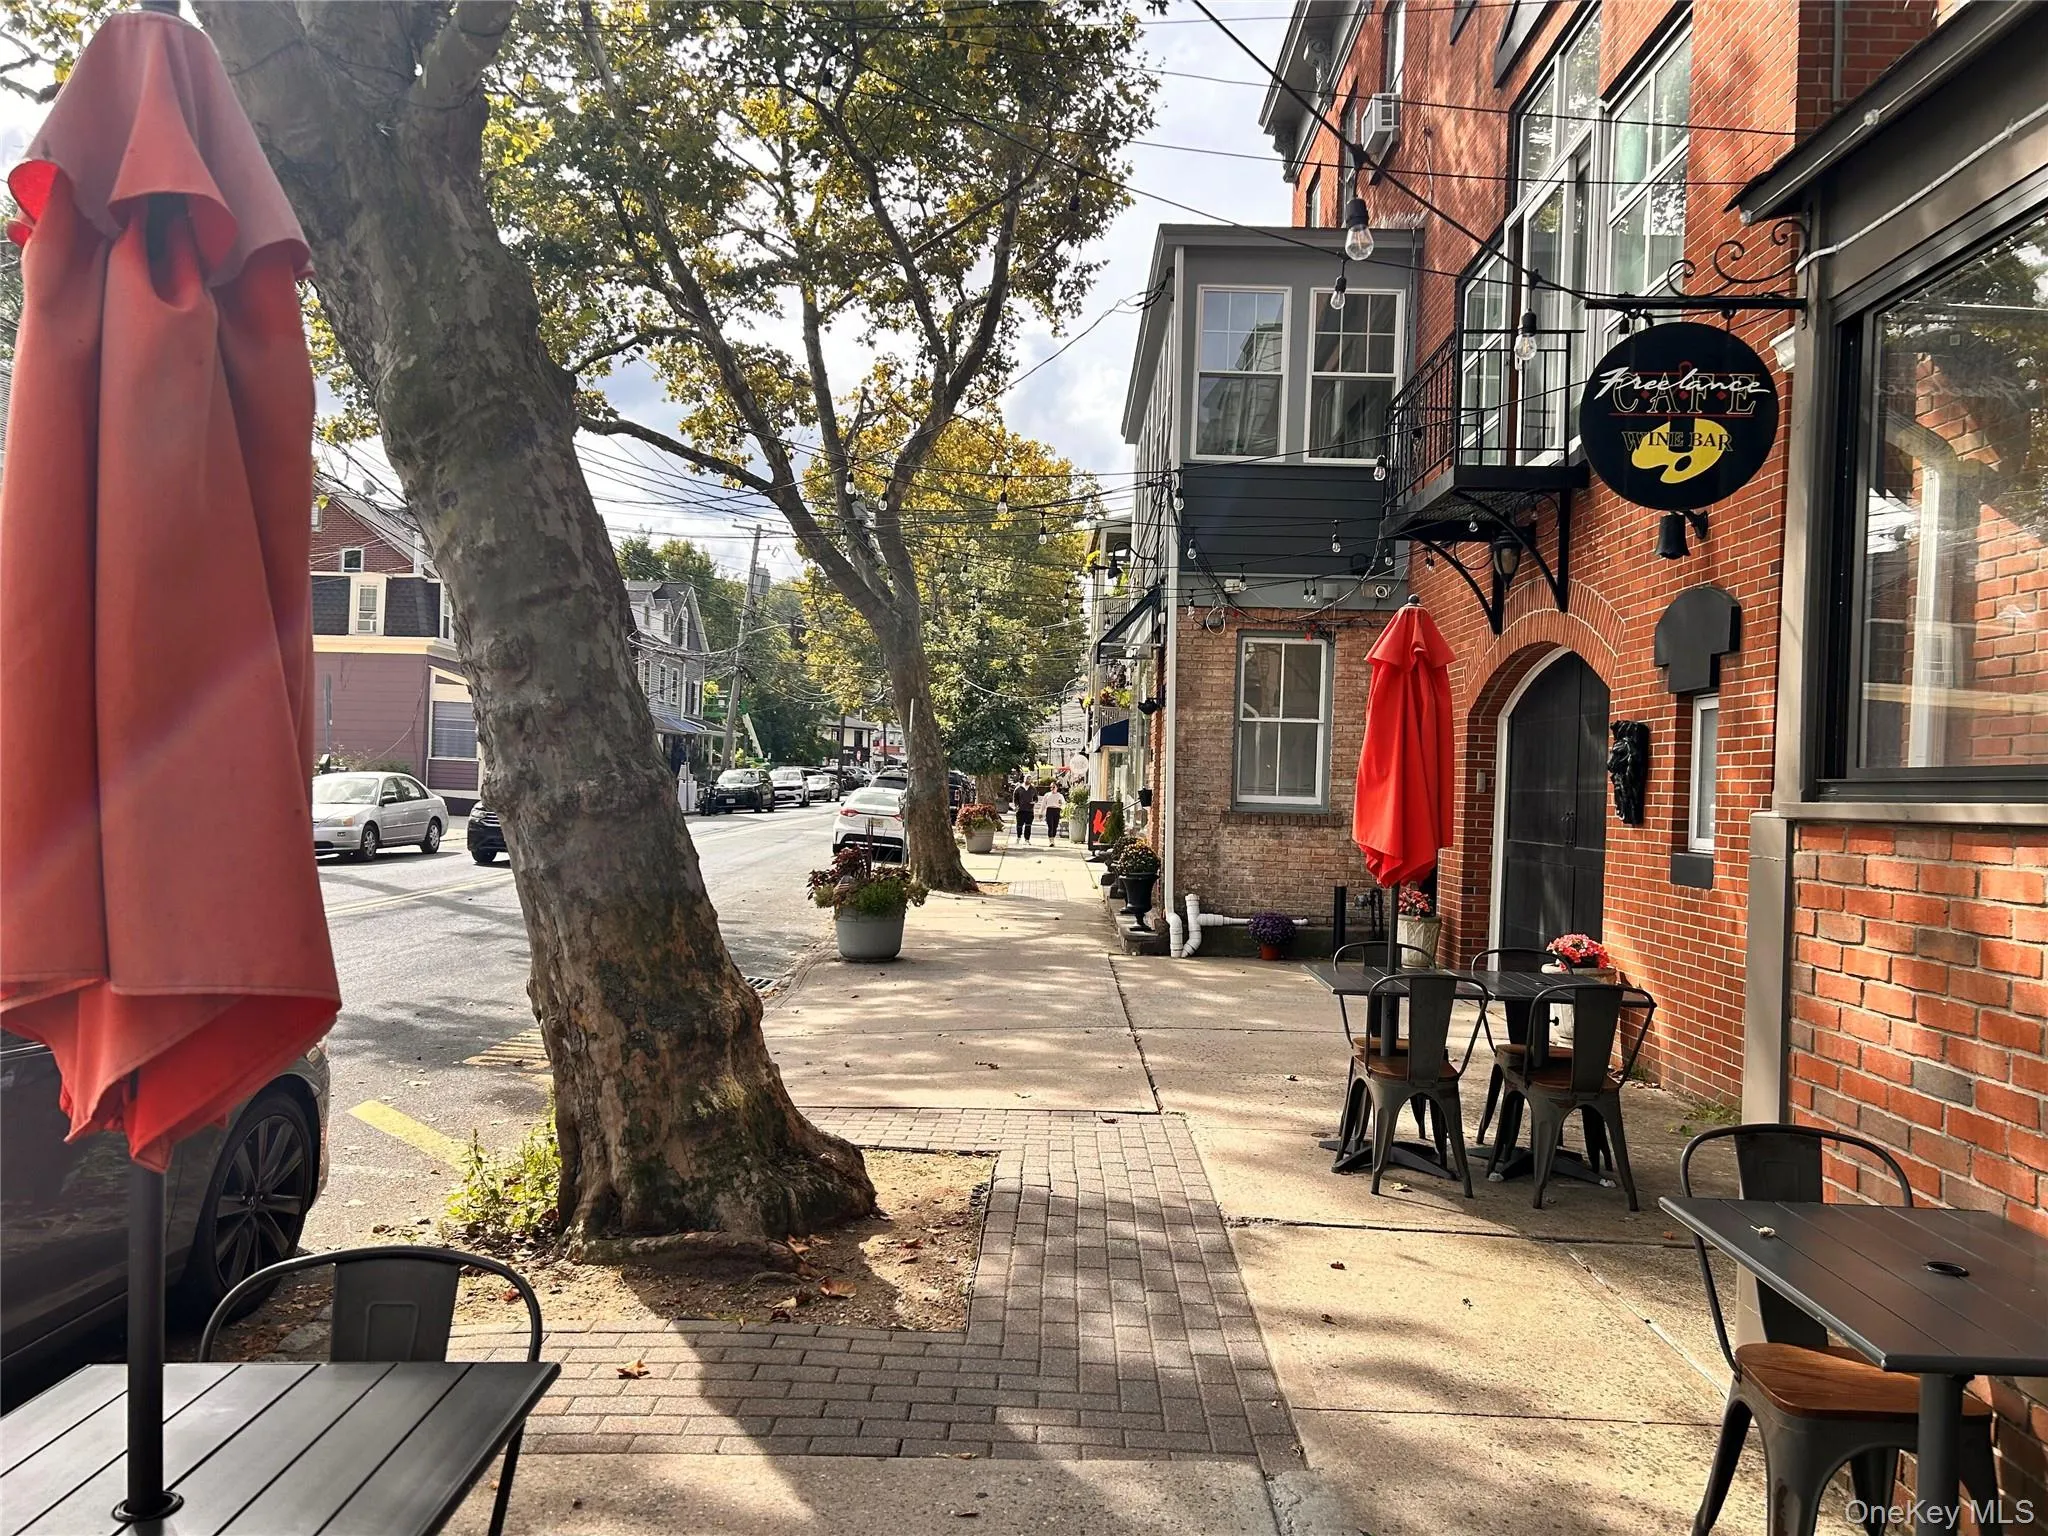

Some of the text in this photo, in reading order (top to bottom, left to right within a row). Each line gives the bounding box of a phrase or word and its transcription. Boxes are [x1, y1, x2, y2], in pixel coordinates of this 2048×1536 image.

[1593, 366, 1771, 400] Freelance
[1612, 372, 1757, 415] CAFE
[1622, 431, 1733, 452] WINE BAR
